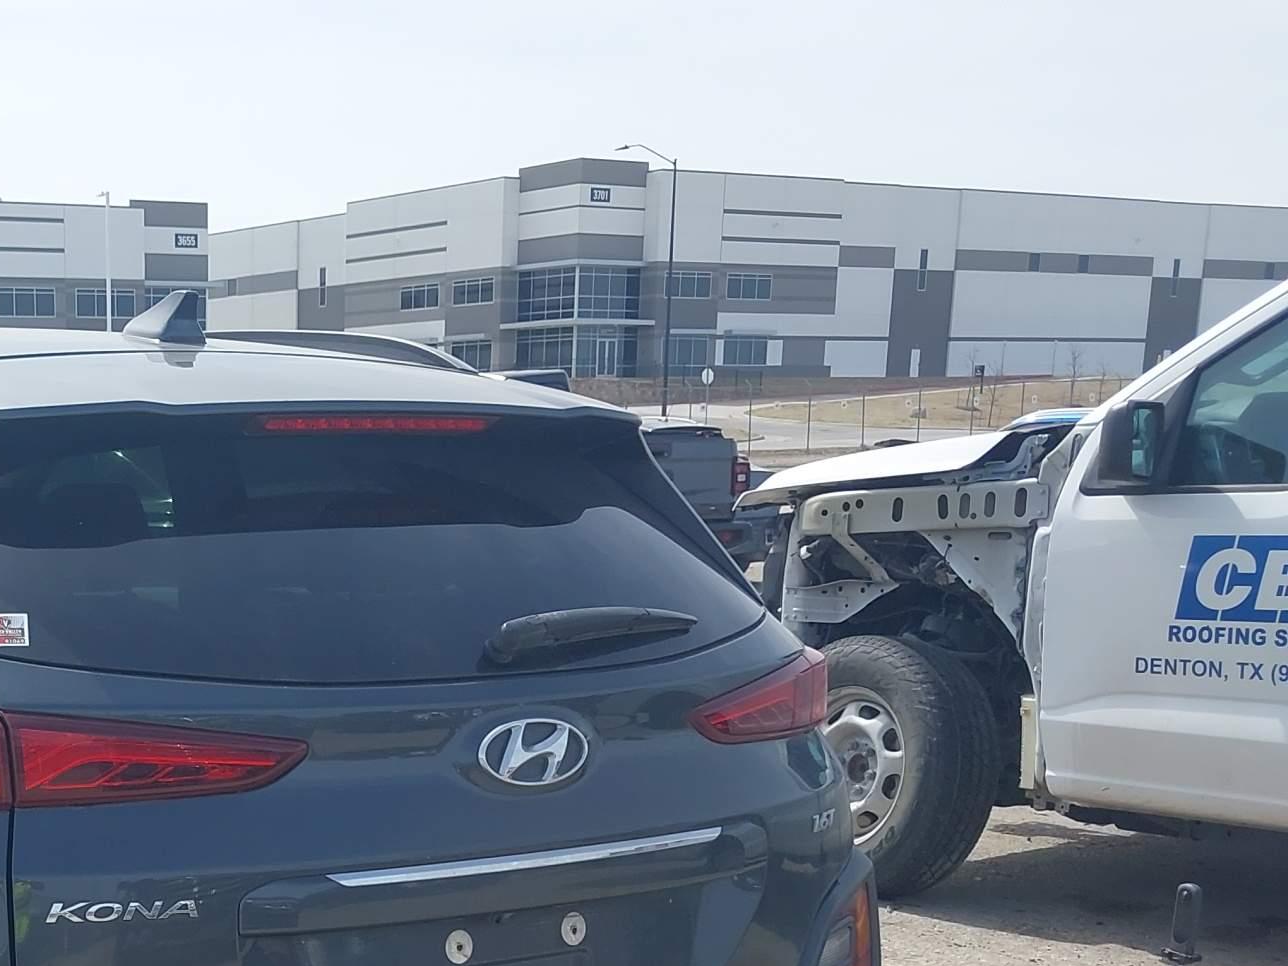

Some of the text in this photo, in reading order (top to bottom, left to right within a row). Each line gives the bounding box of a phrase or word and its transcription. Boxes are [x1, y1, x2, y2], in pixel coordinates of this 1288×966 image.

[592, 190, 609, 201] 3701
[1168, 625, 1267, 646] ROOFING
[1135, 657, 1229, 682] DENTON,
[1236, 662, 1264, 681] TX
[45, 899, 199, 924] KONA
